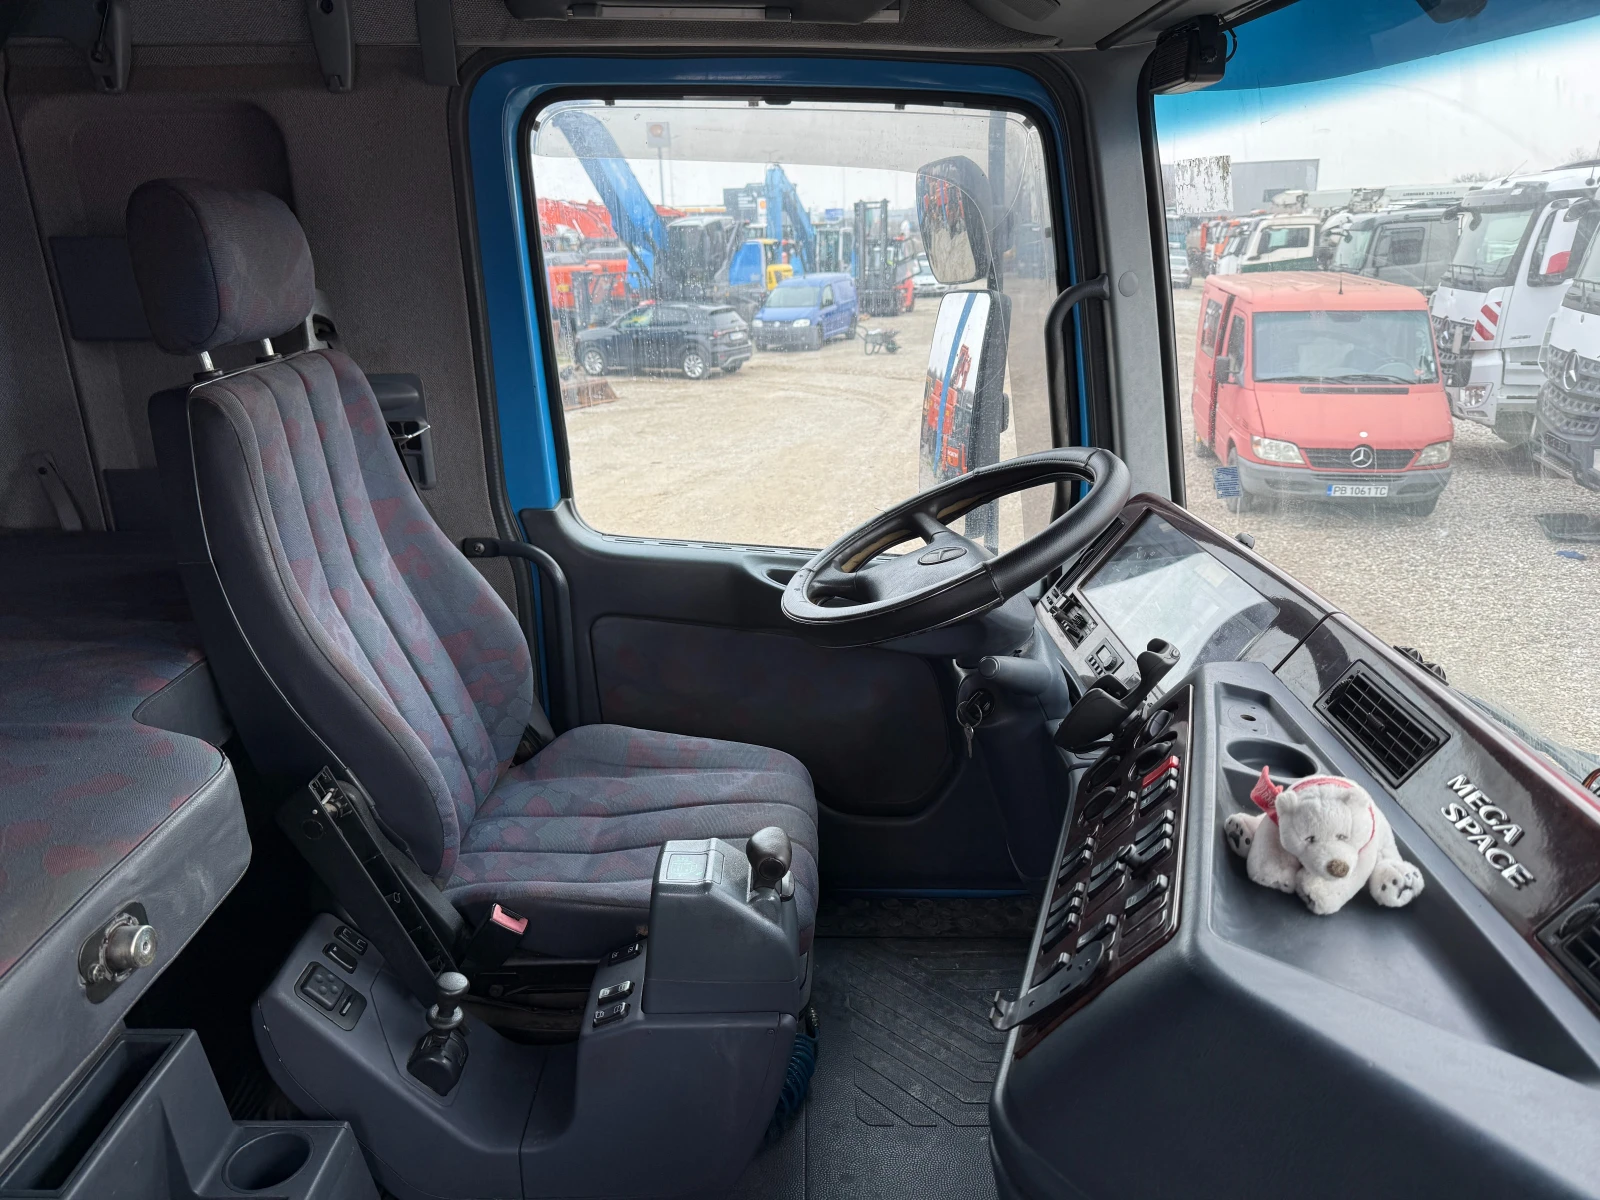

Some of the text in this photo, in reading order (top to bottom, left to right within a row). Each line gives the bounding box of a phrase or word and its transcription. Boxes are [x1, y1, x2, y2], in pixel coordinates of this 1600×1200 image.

[1333, 486, 1387, 496] PB 1061 TC
[1441, 803, 1536, 889] SPACE
[1447, 774, 1524, 846] MEGA
